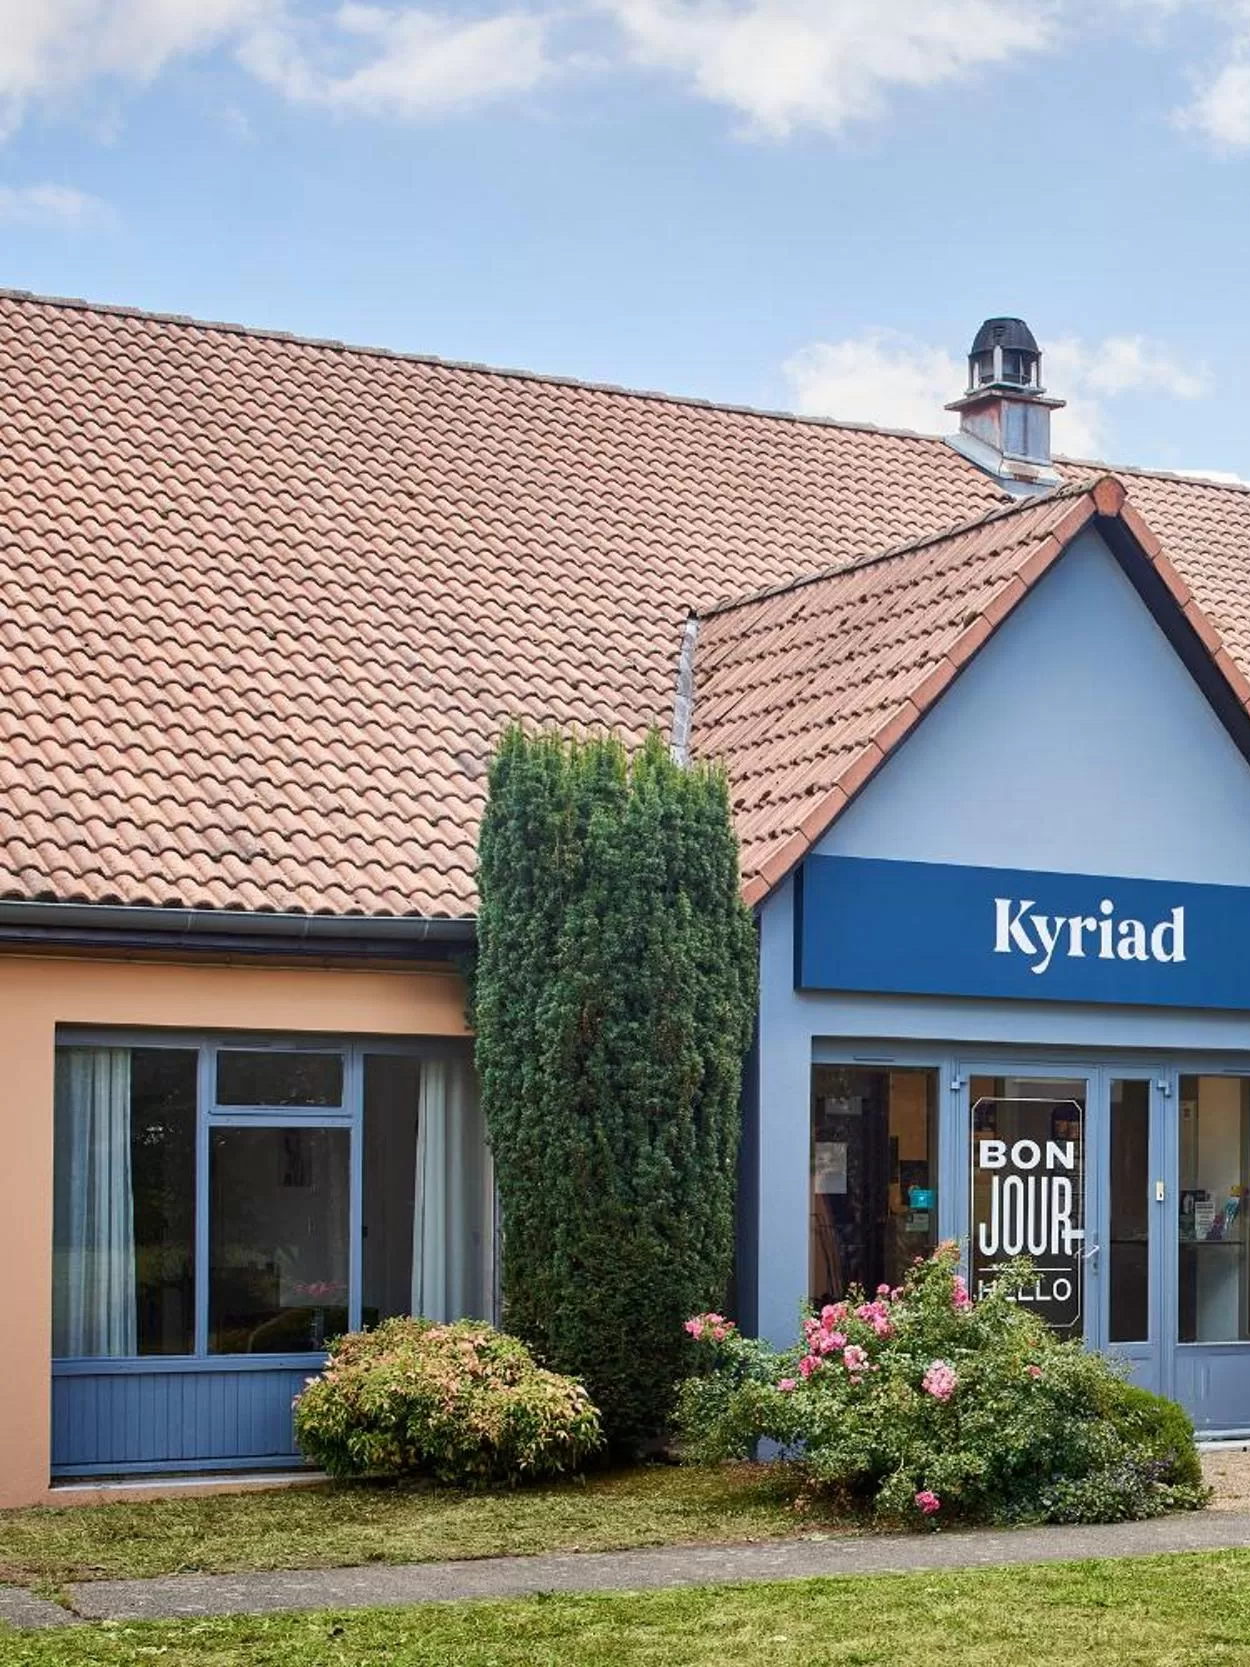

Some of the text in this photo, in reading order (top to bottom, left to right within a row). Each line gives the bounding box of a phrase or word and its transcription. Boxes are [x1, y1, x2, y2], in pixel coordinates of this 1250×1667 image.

[993, 898, 1187, 974] Kyriad
[979, 1140, 1074, 1169] BON
[979, 1175, 1073, 1255] JOUR
[978, 1278, 1072, 1301] HLLO
